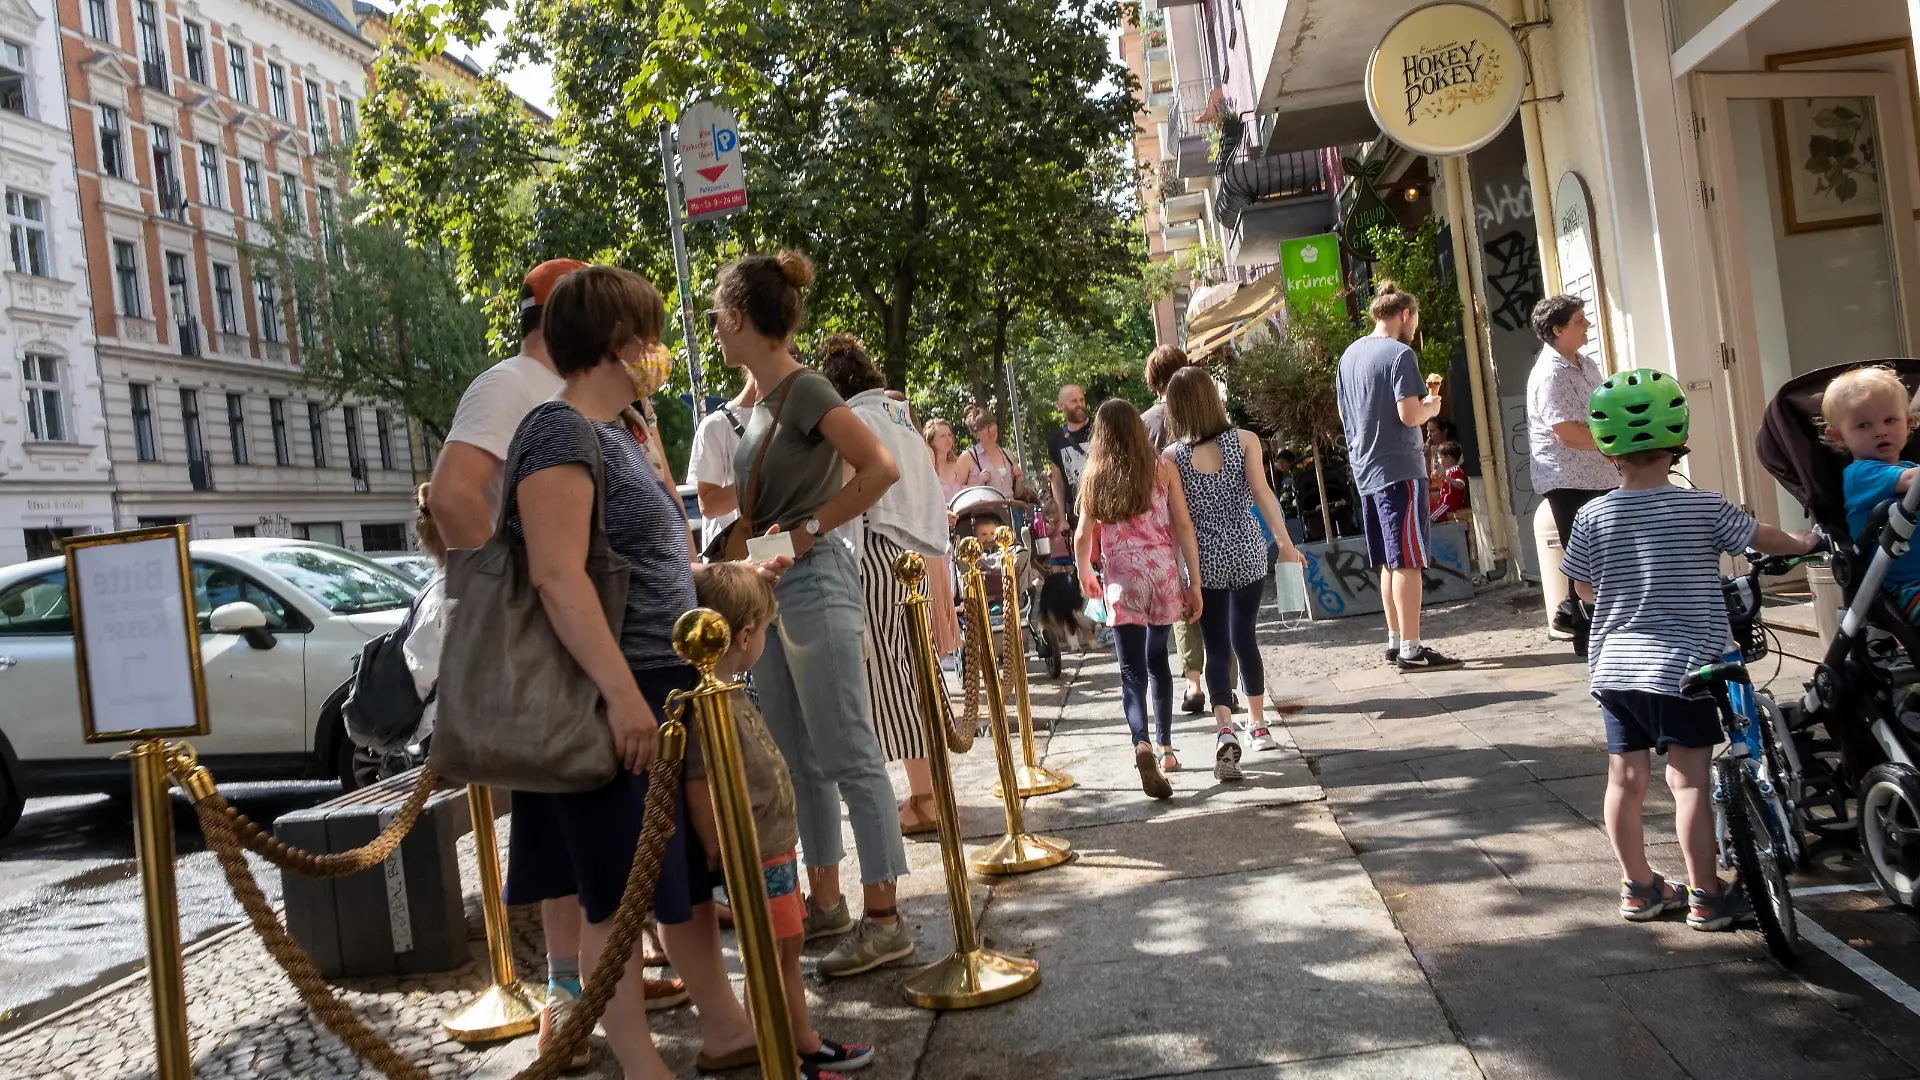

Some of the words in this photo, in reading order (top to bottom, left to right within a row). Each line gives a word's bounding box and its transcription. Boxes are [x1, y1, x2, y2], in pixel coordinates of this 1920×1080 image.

[1402, 39, 1478, 88] HOKEY
[1404, 53, 1484, 126] POKEY
[1354, 206, 1385, 229] LIQUID
[1287, 269, 1339, 291] krümel
